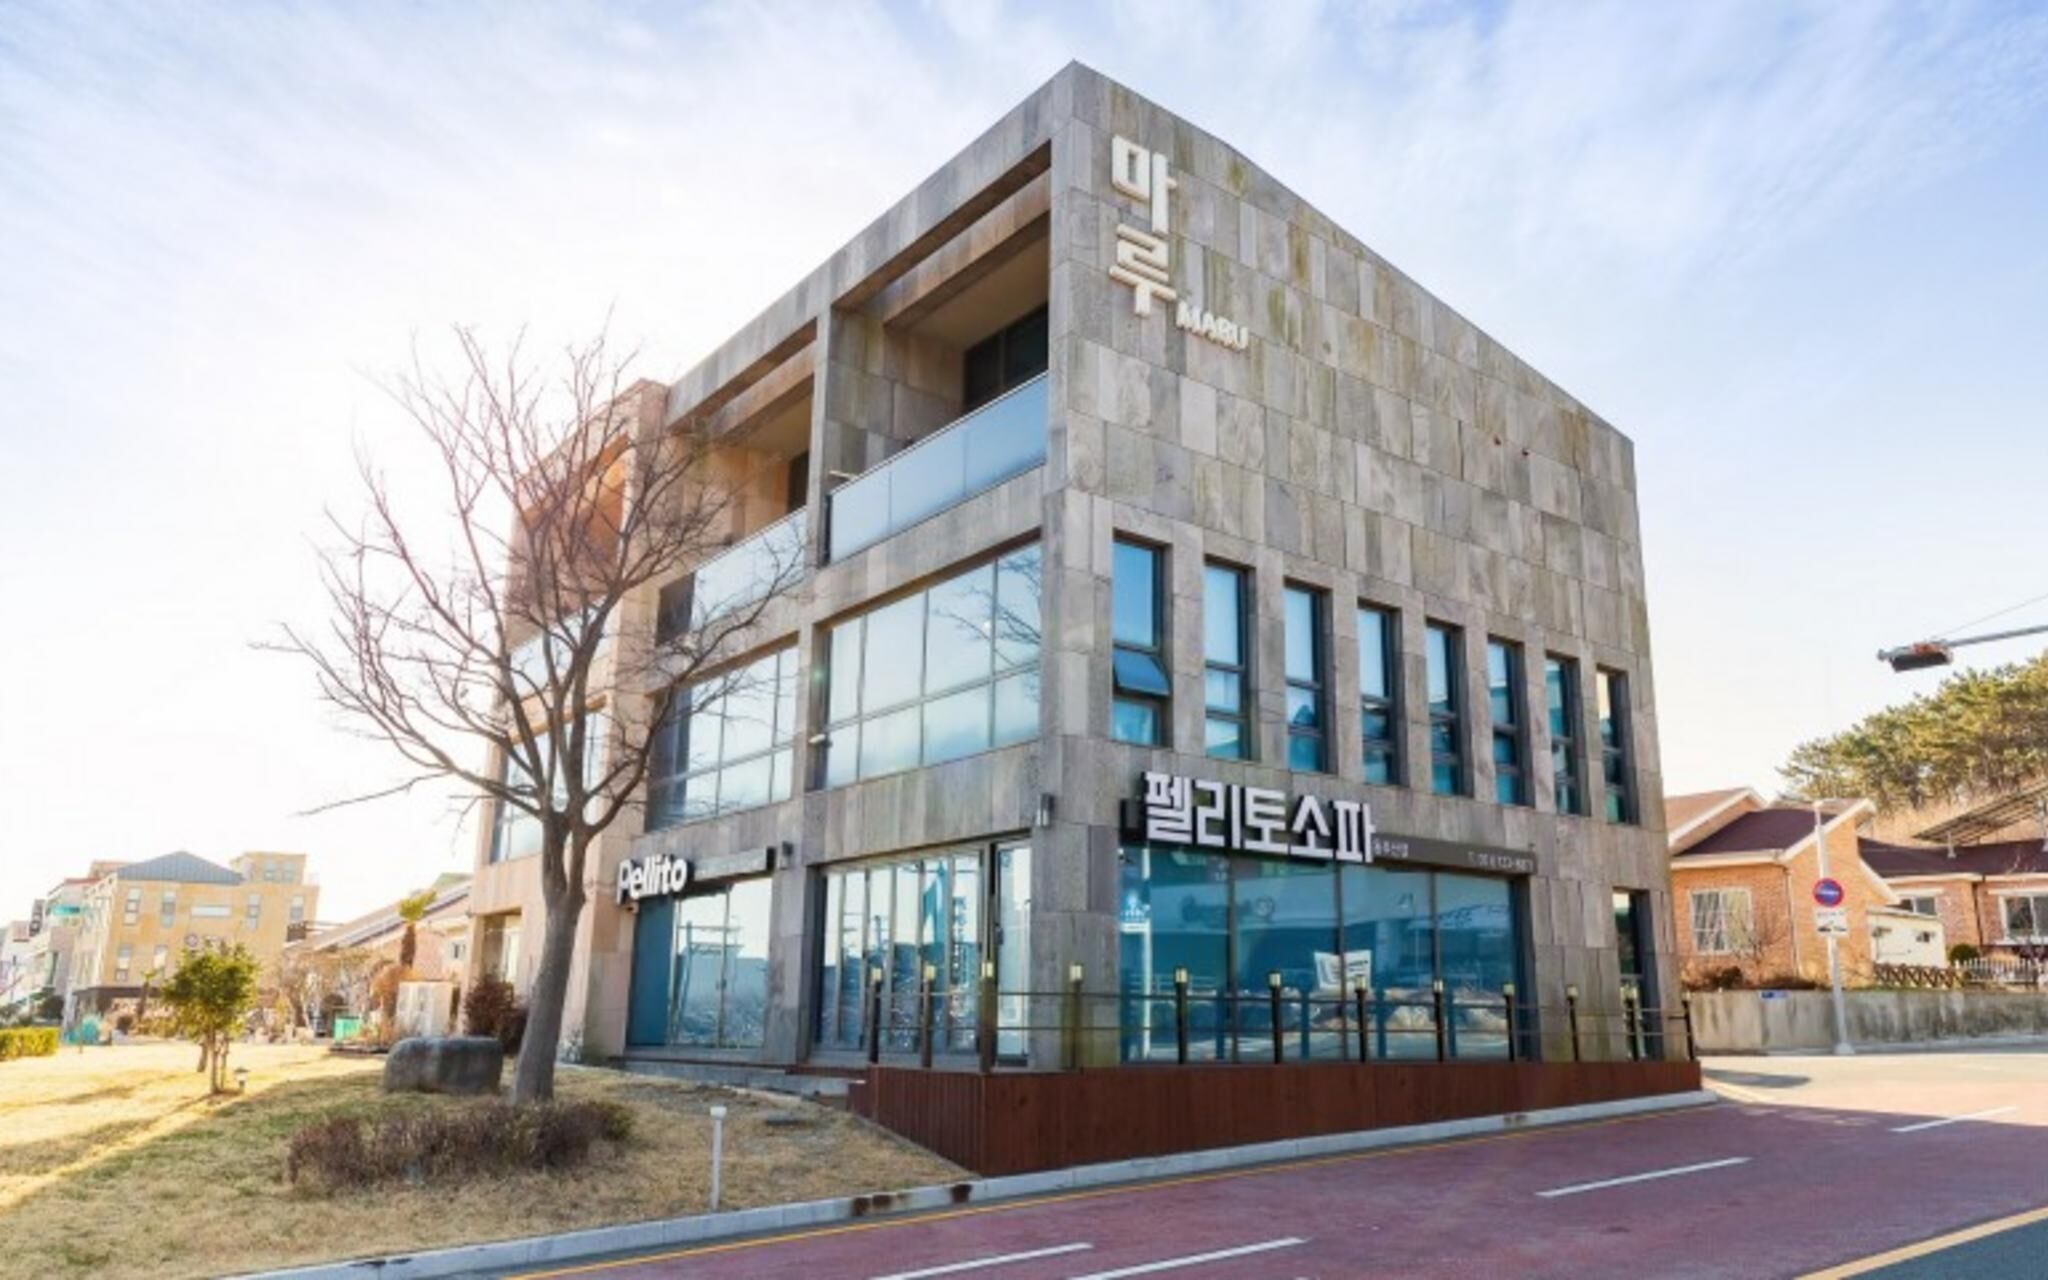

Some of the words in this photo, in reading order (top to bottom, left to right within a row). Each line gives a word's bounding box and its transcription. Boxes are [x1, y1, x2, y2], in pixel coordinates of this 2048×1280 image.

[1109, 135, 1177, 316] 마루
[1176, 300, 1249, 350] MARU
[1145, 771, 1376, 863] 펠리토소파
[617, 855, 687, 903] Pellito
